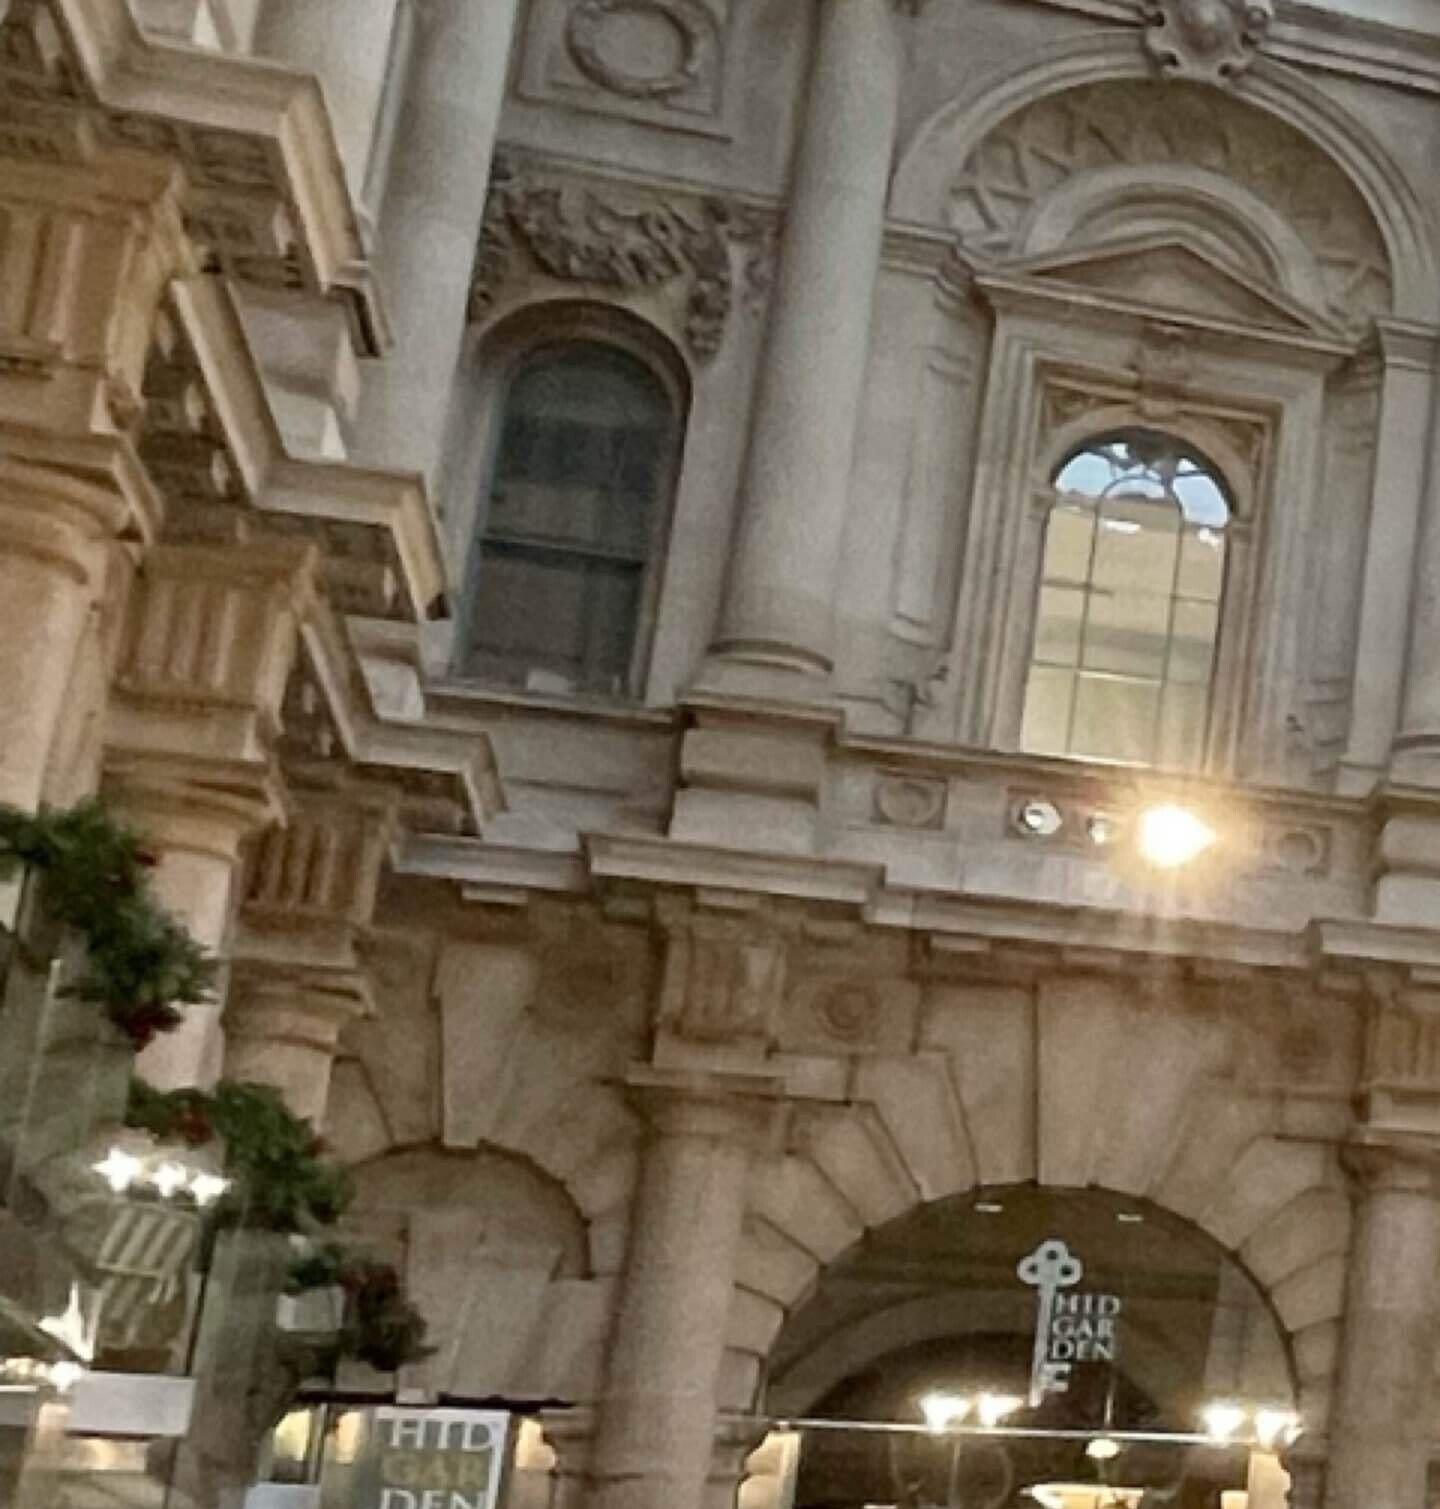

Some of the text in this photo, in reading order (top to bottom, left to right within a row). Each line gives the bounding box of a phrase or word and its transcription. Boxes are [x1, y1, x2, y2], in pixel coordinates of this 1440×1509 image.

[1055, 1294, 1121, 1314] HID
[1051, 1316, 1115, 1338] GAR
[1051, 1339, 1114, 1360] DEN
[388, 1417, 498, 1451] HID
